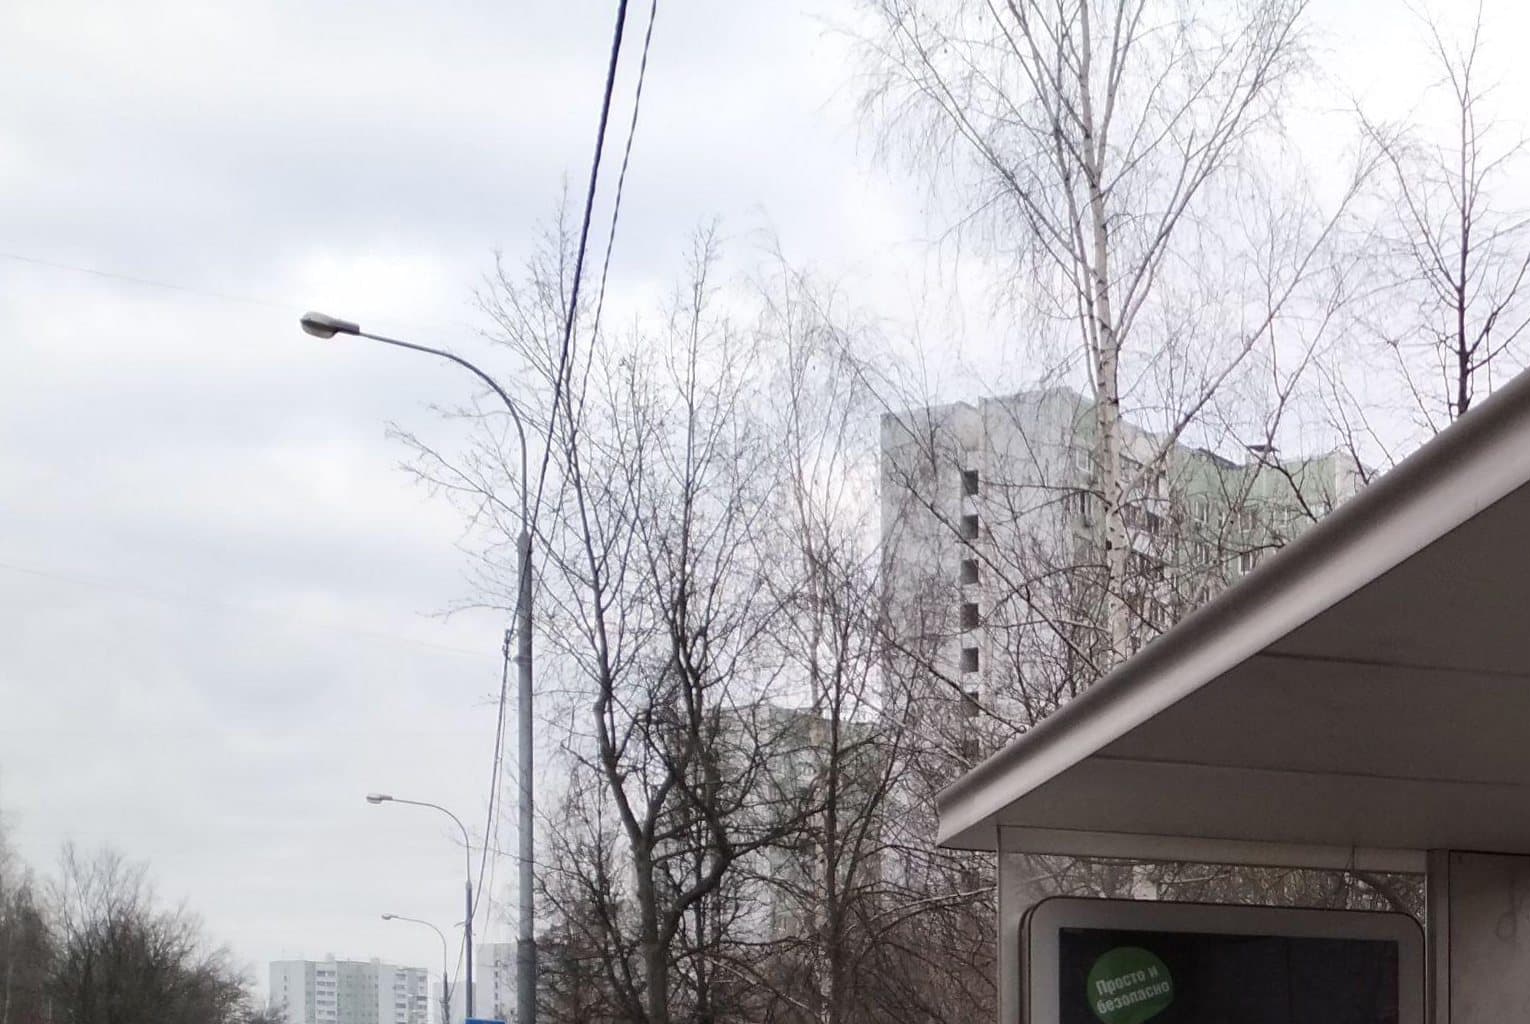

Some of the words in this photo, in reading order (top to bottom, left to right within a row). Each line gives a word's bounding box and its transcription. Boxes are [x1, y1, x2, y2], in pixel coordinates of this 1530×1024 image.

[1095, 970, 1146, 996] Просто
[1147, 965, 1159, 978] и
[1096, 981, 1170, 1014] безопасно
